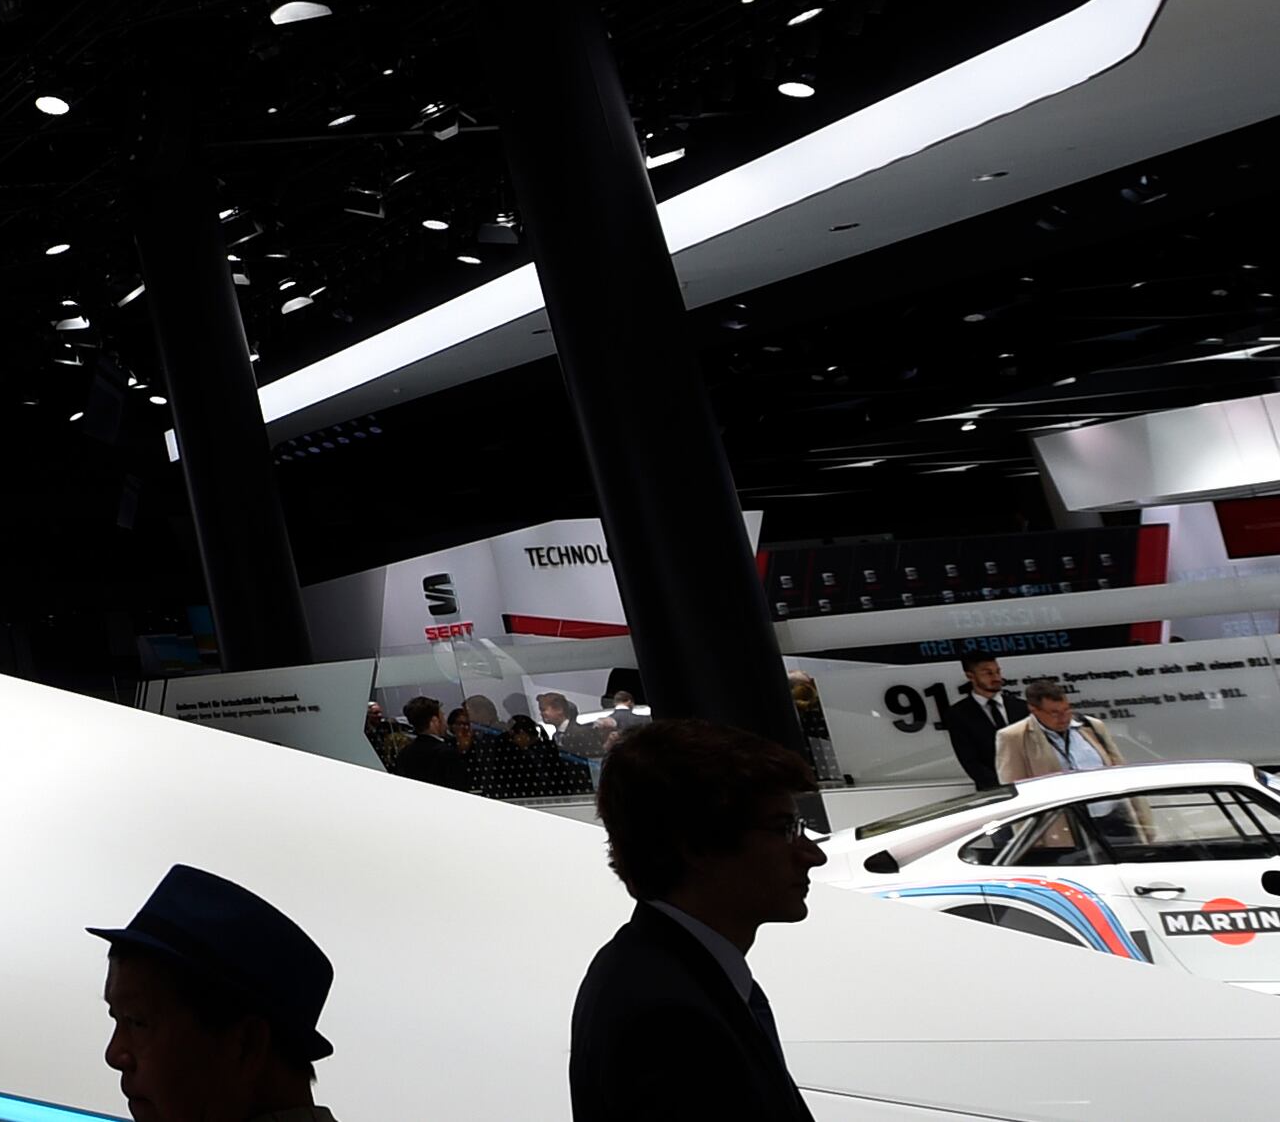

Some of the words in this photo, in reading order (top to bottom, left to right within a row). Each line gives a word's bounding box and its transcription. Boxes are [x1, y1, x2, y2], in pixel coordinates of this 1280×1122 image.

[524, 544, 611, 567] TECHNOL
[425, 622, 474, 642] SEAT
[1247, 657, 1270, 667] 911
[884, 682, 972, 733] 91
